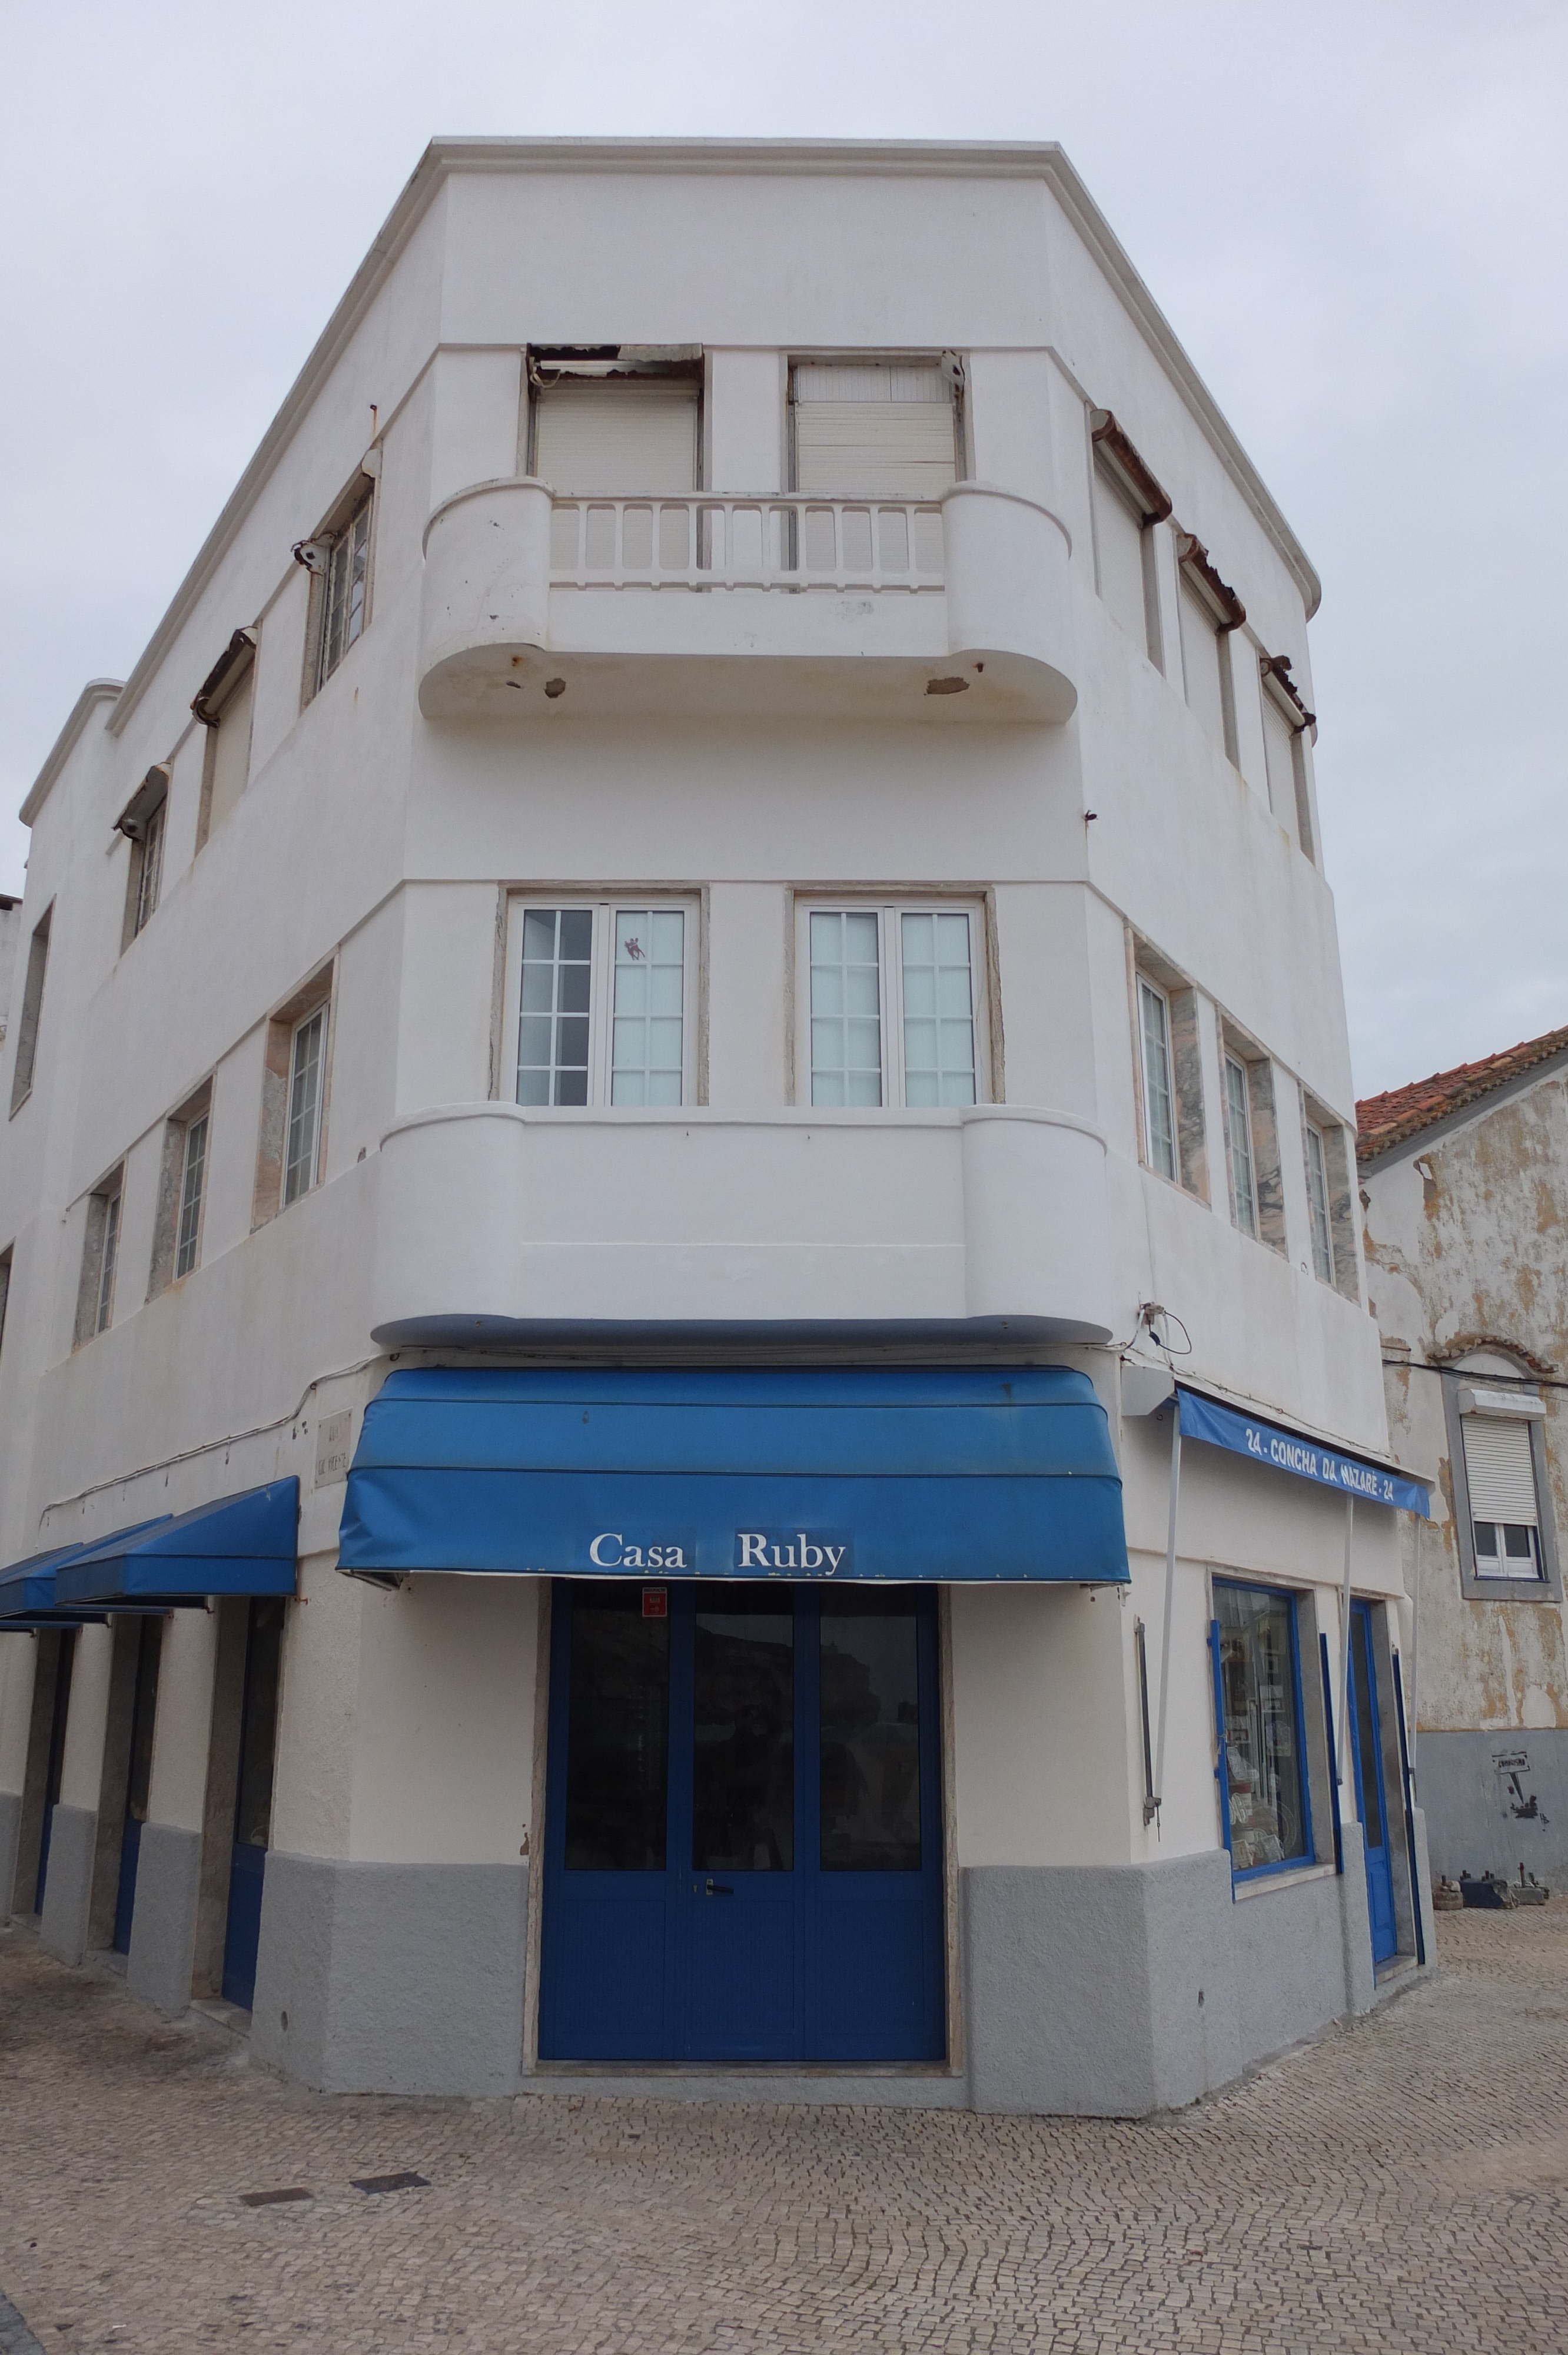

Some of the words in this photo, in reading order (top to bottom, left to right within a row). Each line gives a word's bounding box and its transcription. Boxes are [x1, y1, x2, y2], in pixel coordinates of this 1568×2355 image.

[328, 1452, 346, 1472] VICETE
[1245, 1428, 1263, 1455] 24
[1270, 1438, 1318, 1476] CONCHA
[1322, 1457, 1338, 1482] DA
[1340, 1464, 1378, 1496] NAZARÉ
[1383, 1480, 1394, 1501] 24
[589, 1533, 687, 1567] Casa
[737, 1533, 846, 1575] Ruby
